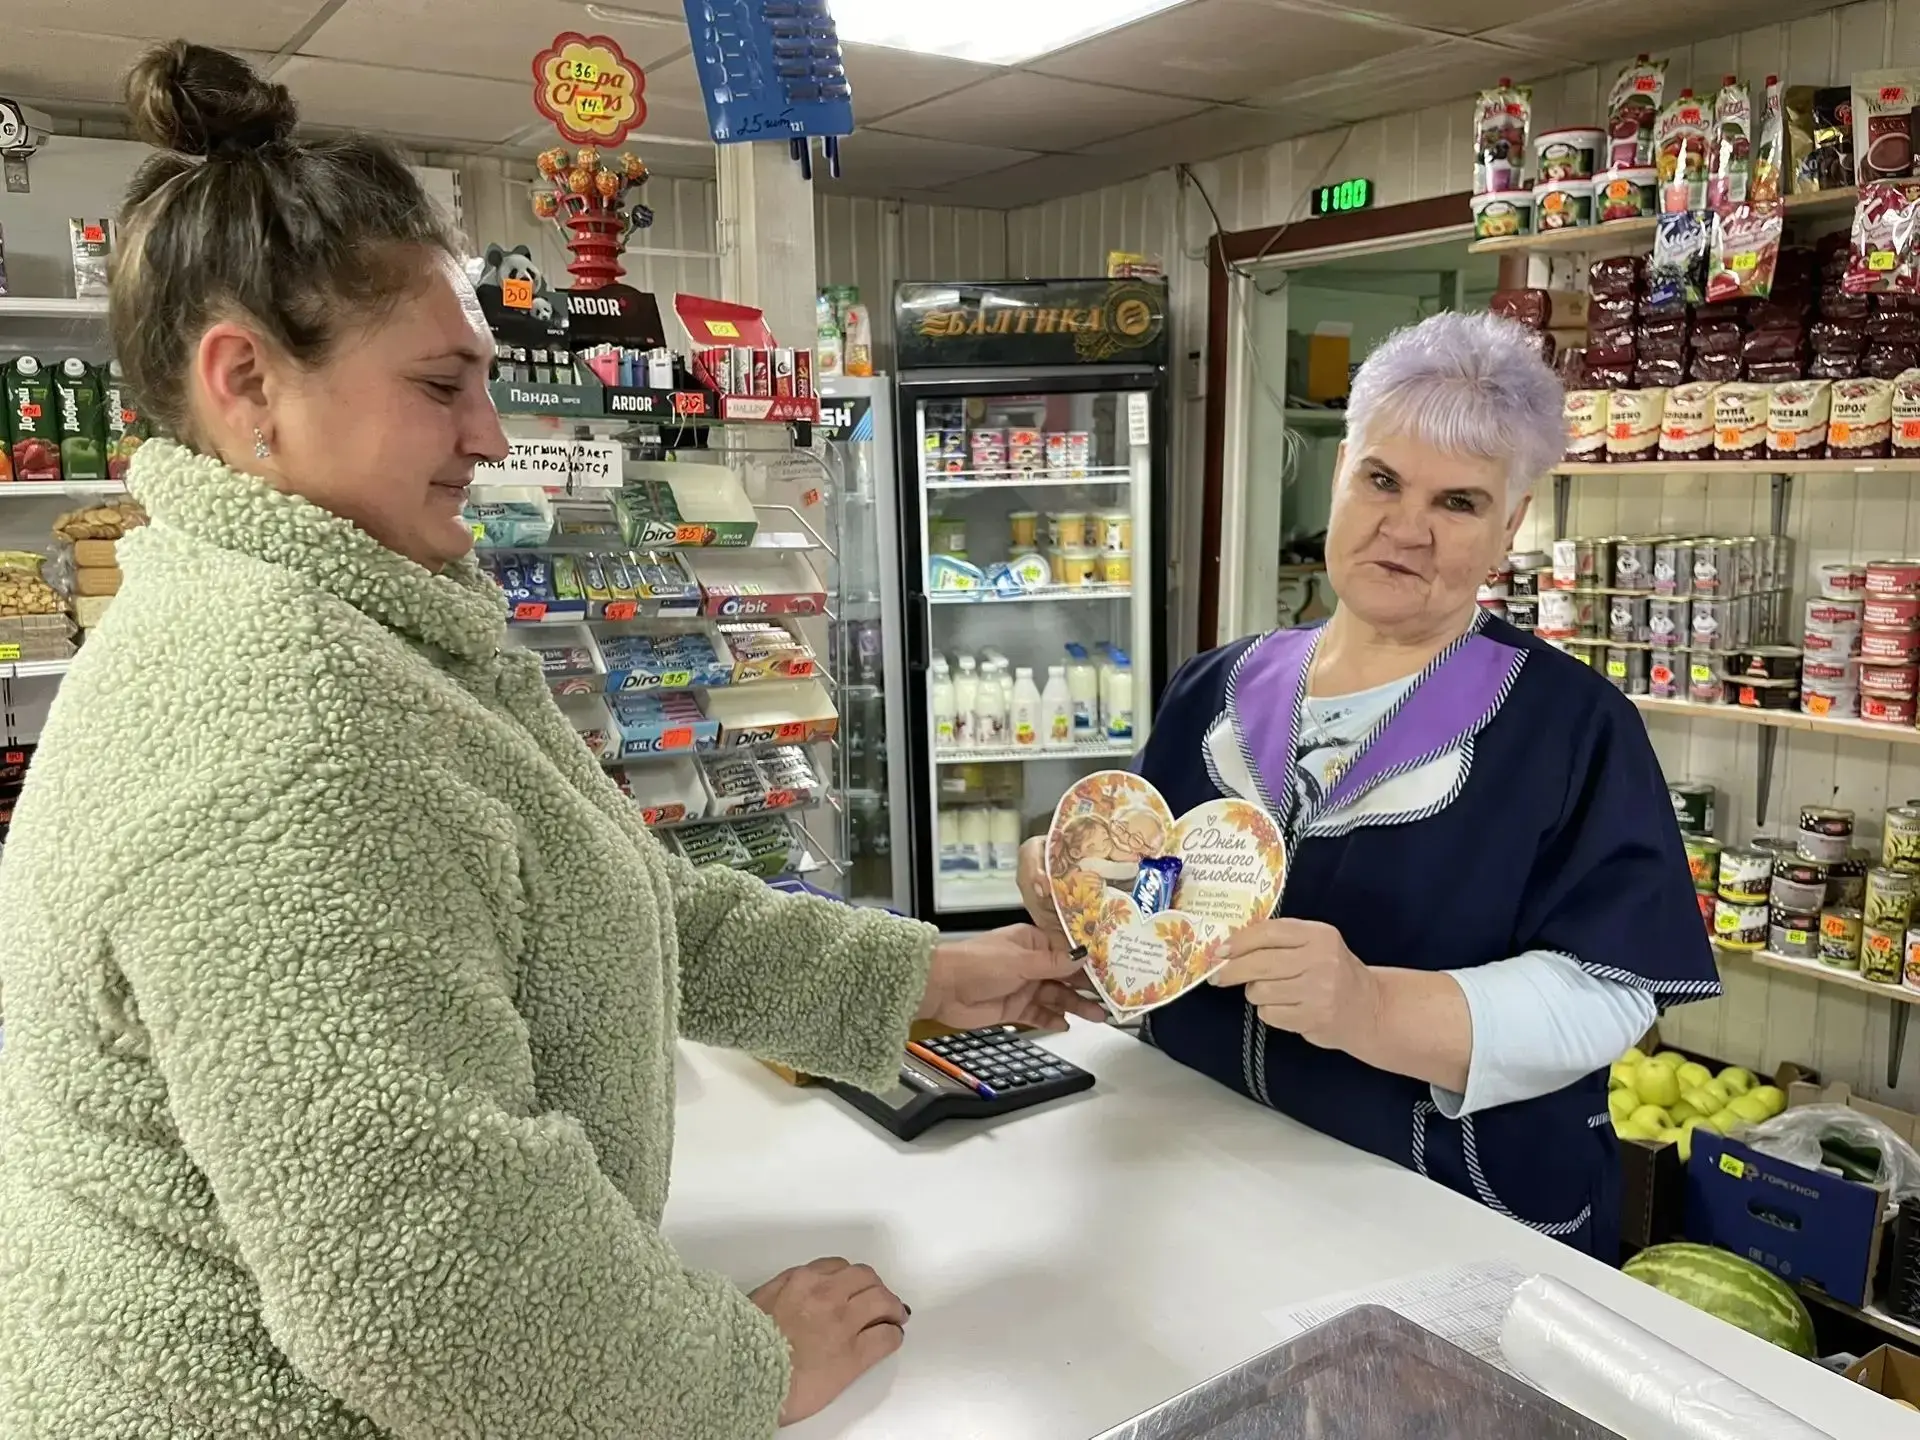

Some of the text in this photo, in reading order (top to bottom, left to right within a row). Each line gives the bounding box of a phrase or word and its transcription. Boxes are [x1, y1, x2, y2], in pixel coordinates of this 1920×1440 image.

[555, 60, 625, 91] Cpa
[506, 288, 528, 303] 30
[567, 297, 622, 316] ARDOR
[947, 307, 1101, 335] БАЛТИКА
[510, 389, 559, 406] Панда
[612, 395, 652, 412] ARDOR
[1834, 403, 1866, 413] ГОРОХ
[509, 445, 567, 457] СТИГШИМ
[511, 460, 527, 470] НЕ
[642, 531, 677, 542] Diro
[722, 599, 768, 614] Orbit
[736, 730, 776, 746] Dirol
[1183, 828, 1246, 851] С Днём
[1183, 853, 1254, 866] пожилого
[1191, 864, 1264, 884] человека!
